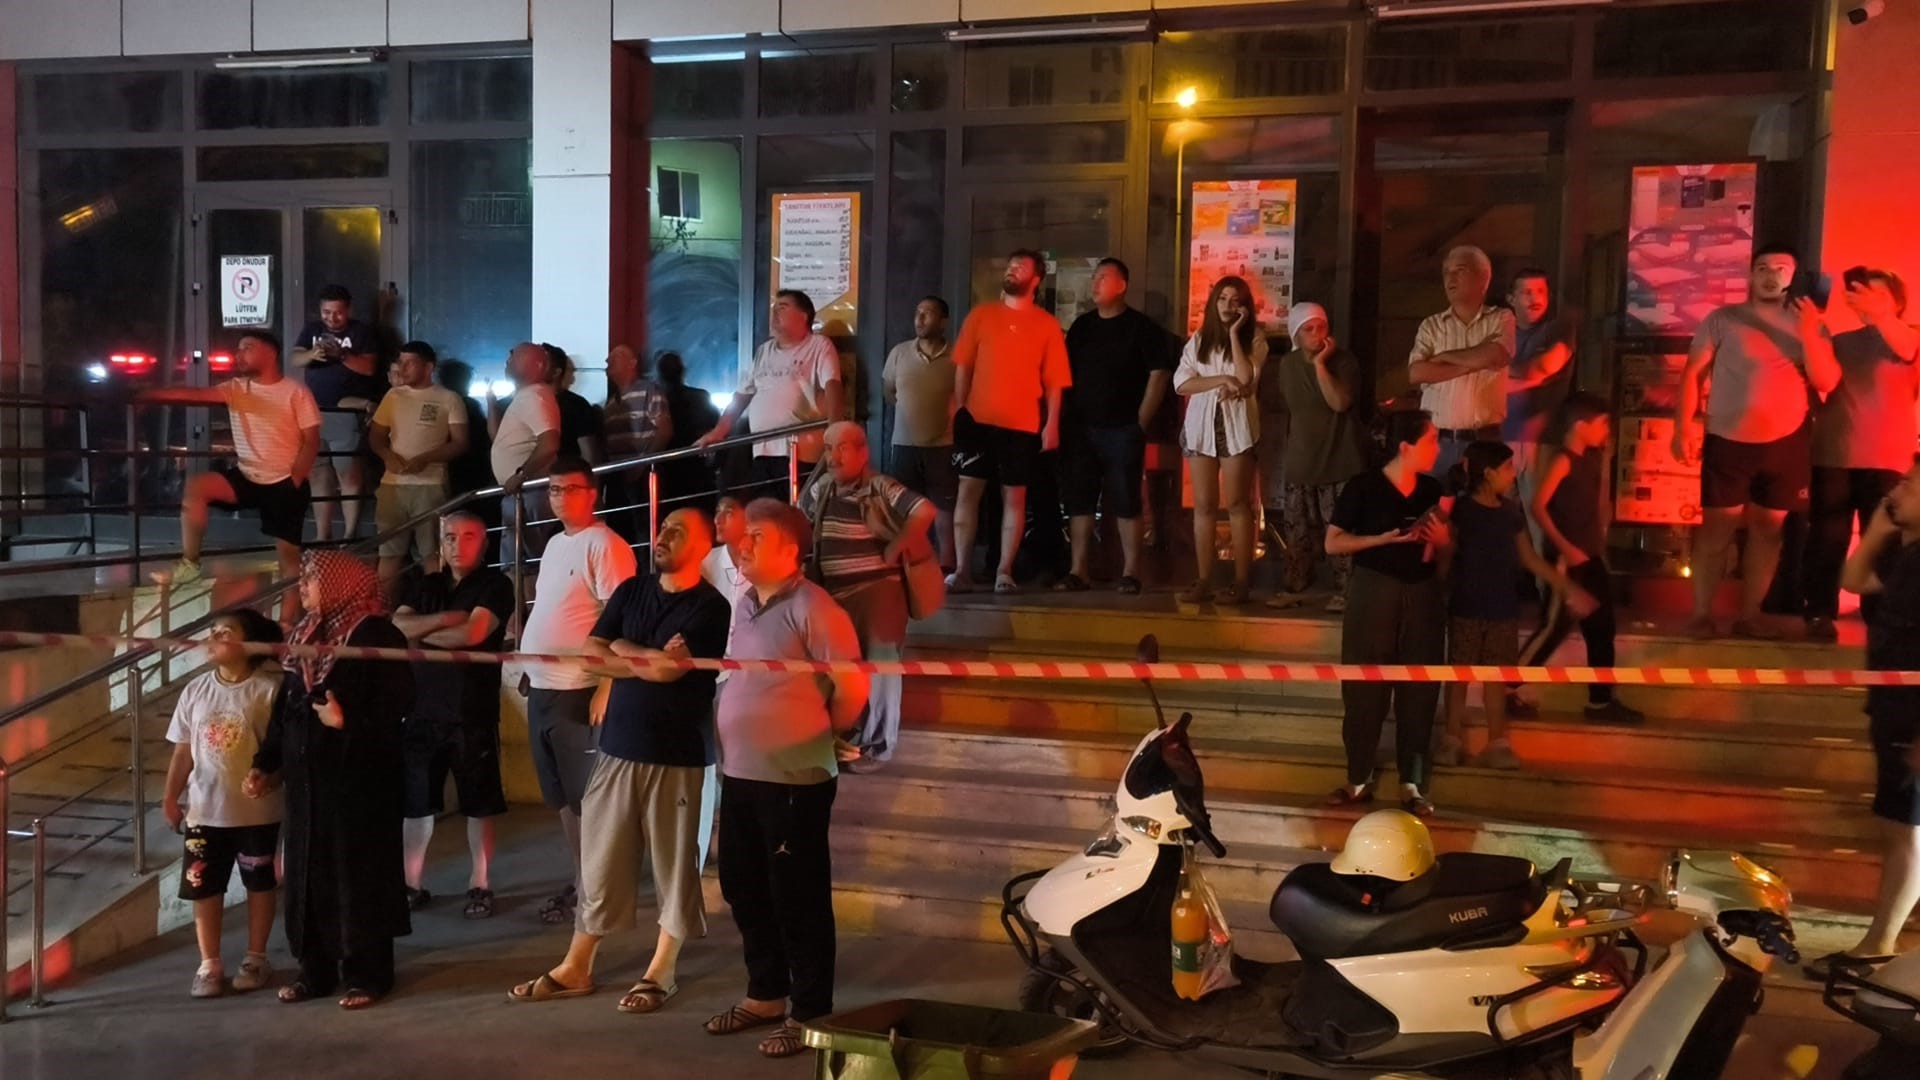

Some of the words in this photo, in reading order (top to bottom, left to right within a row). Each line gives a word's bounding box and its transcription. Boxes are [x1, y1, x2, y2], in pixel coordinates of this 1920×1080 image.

[226, 257, 241, 266] DEPO
[235, 303, 258, 313] LÜTFEN
[1449, 906, 1489, 924] KUBA
